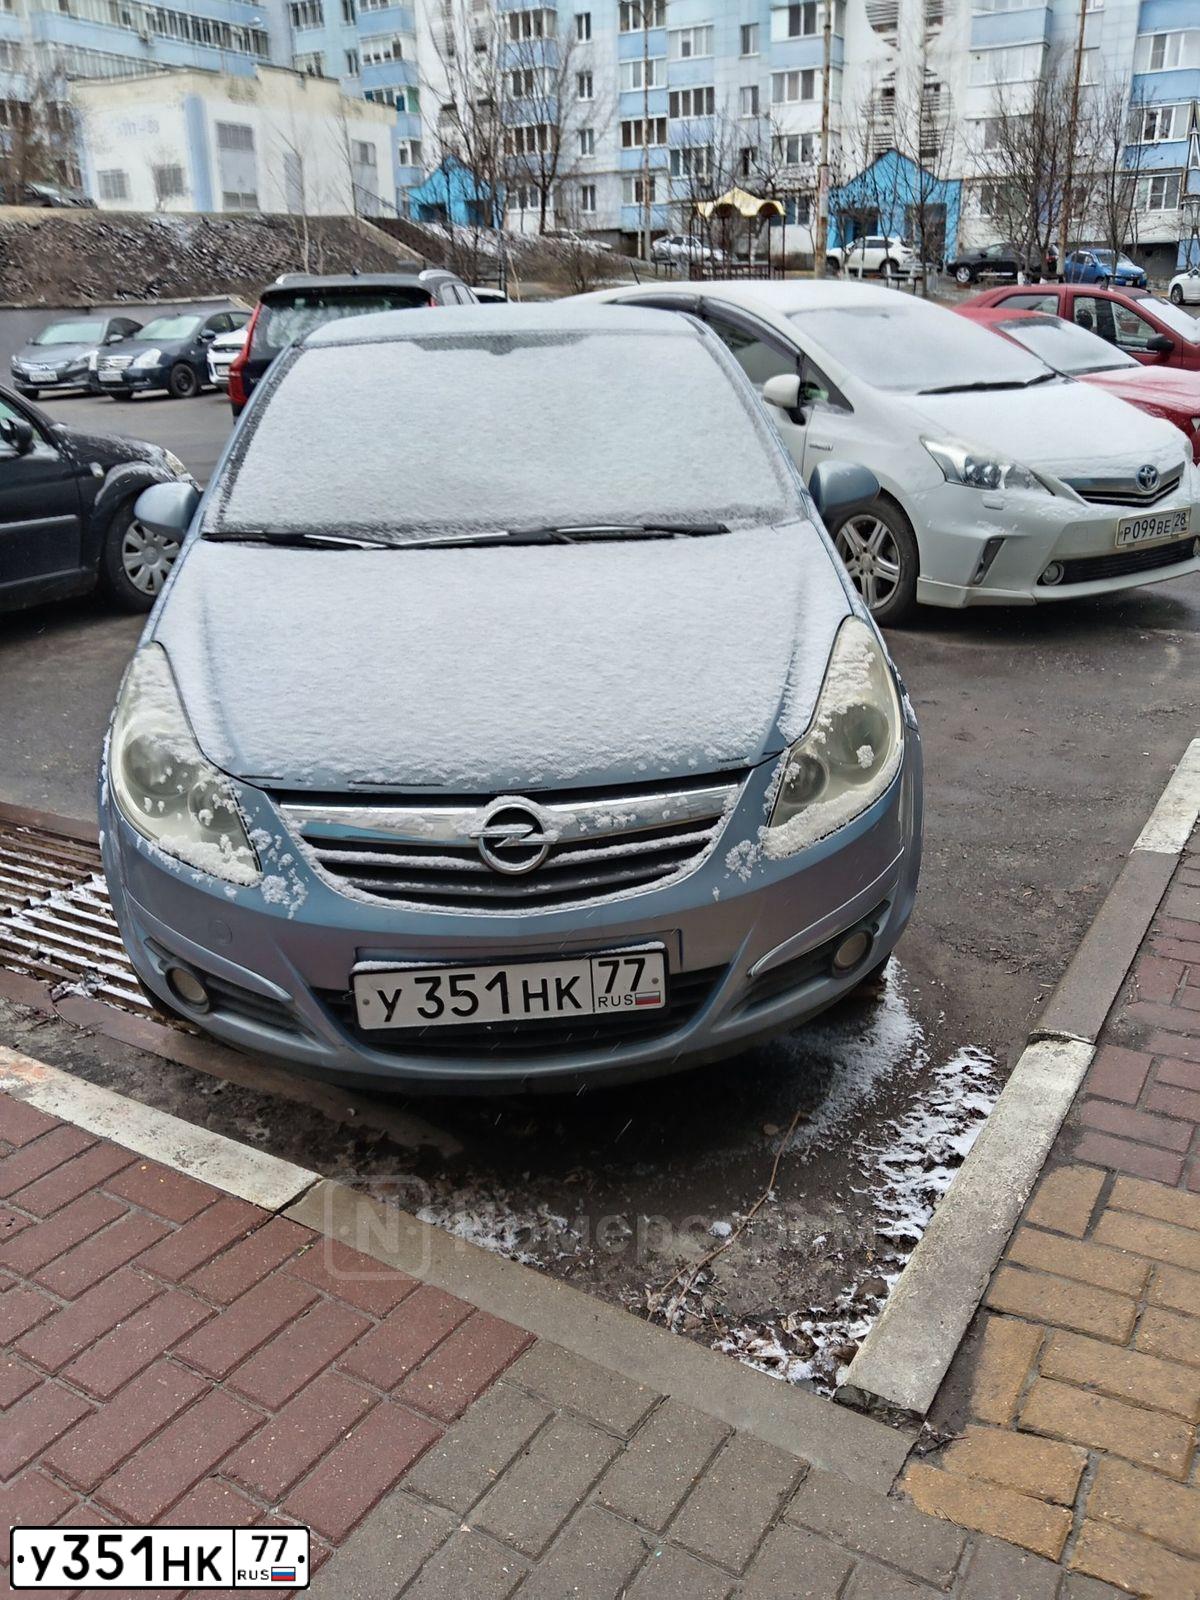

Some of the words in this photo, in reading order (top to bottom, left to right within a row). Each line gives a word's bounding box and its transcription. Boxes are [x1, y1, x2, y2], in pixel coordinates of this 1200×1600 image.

[1174, 512, 1187, 528] 28
[376, 971, 583, 1023] У351НК
[598, 957, 646, 994] 77
[598, 993, 633, 1008] RUS
